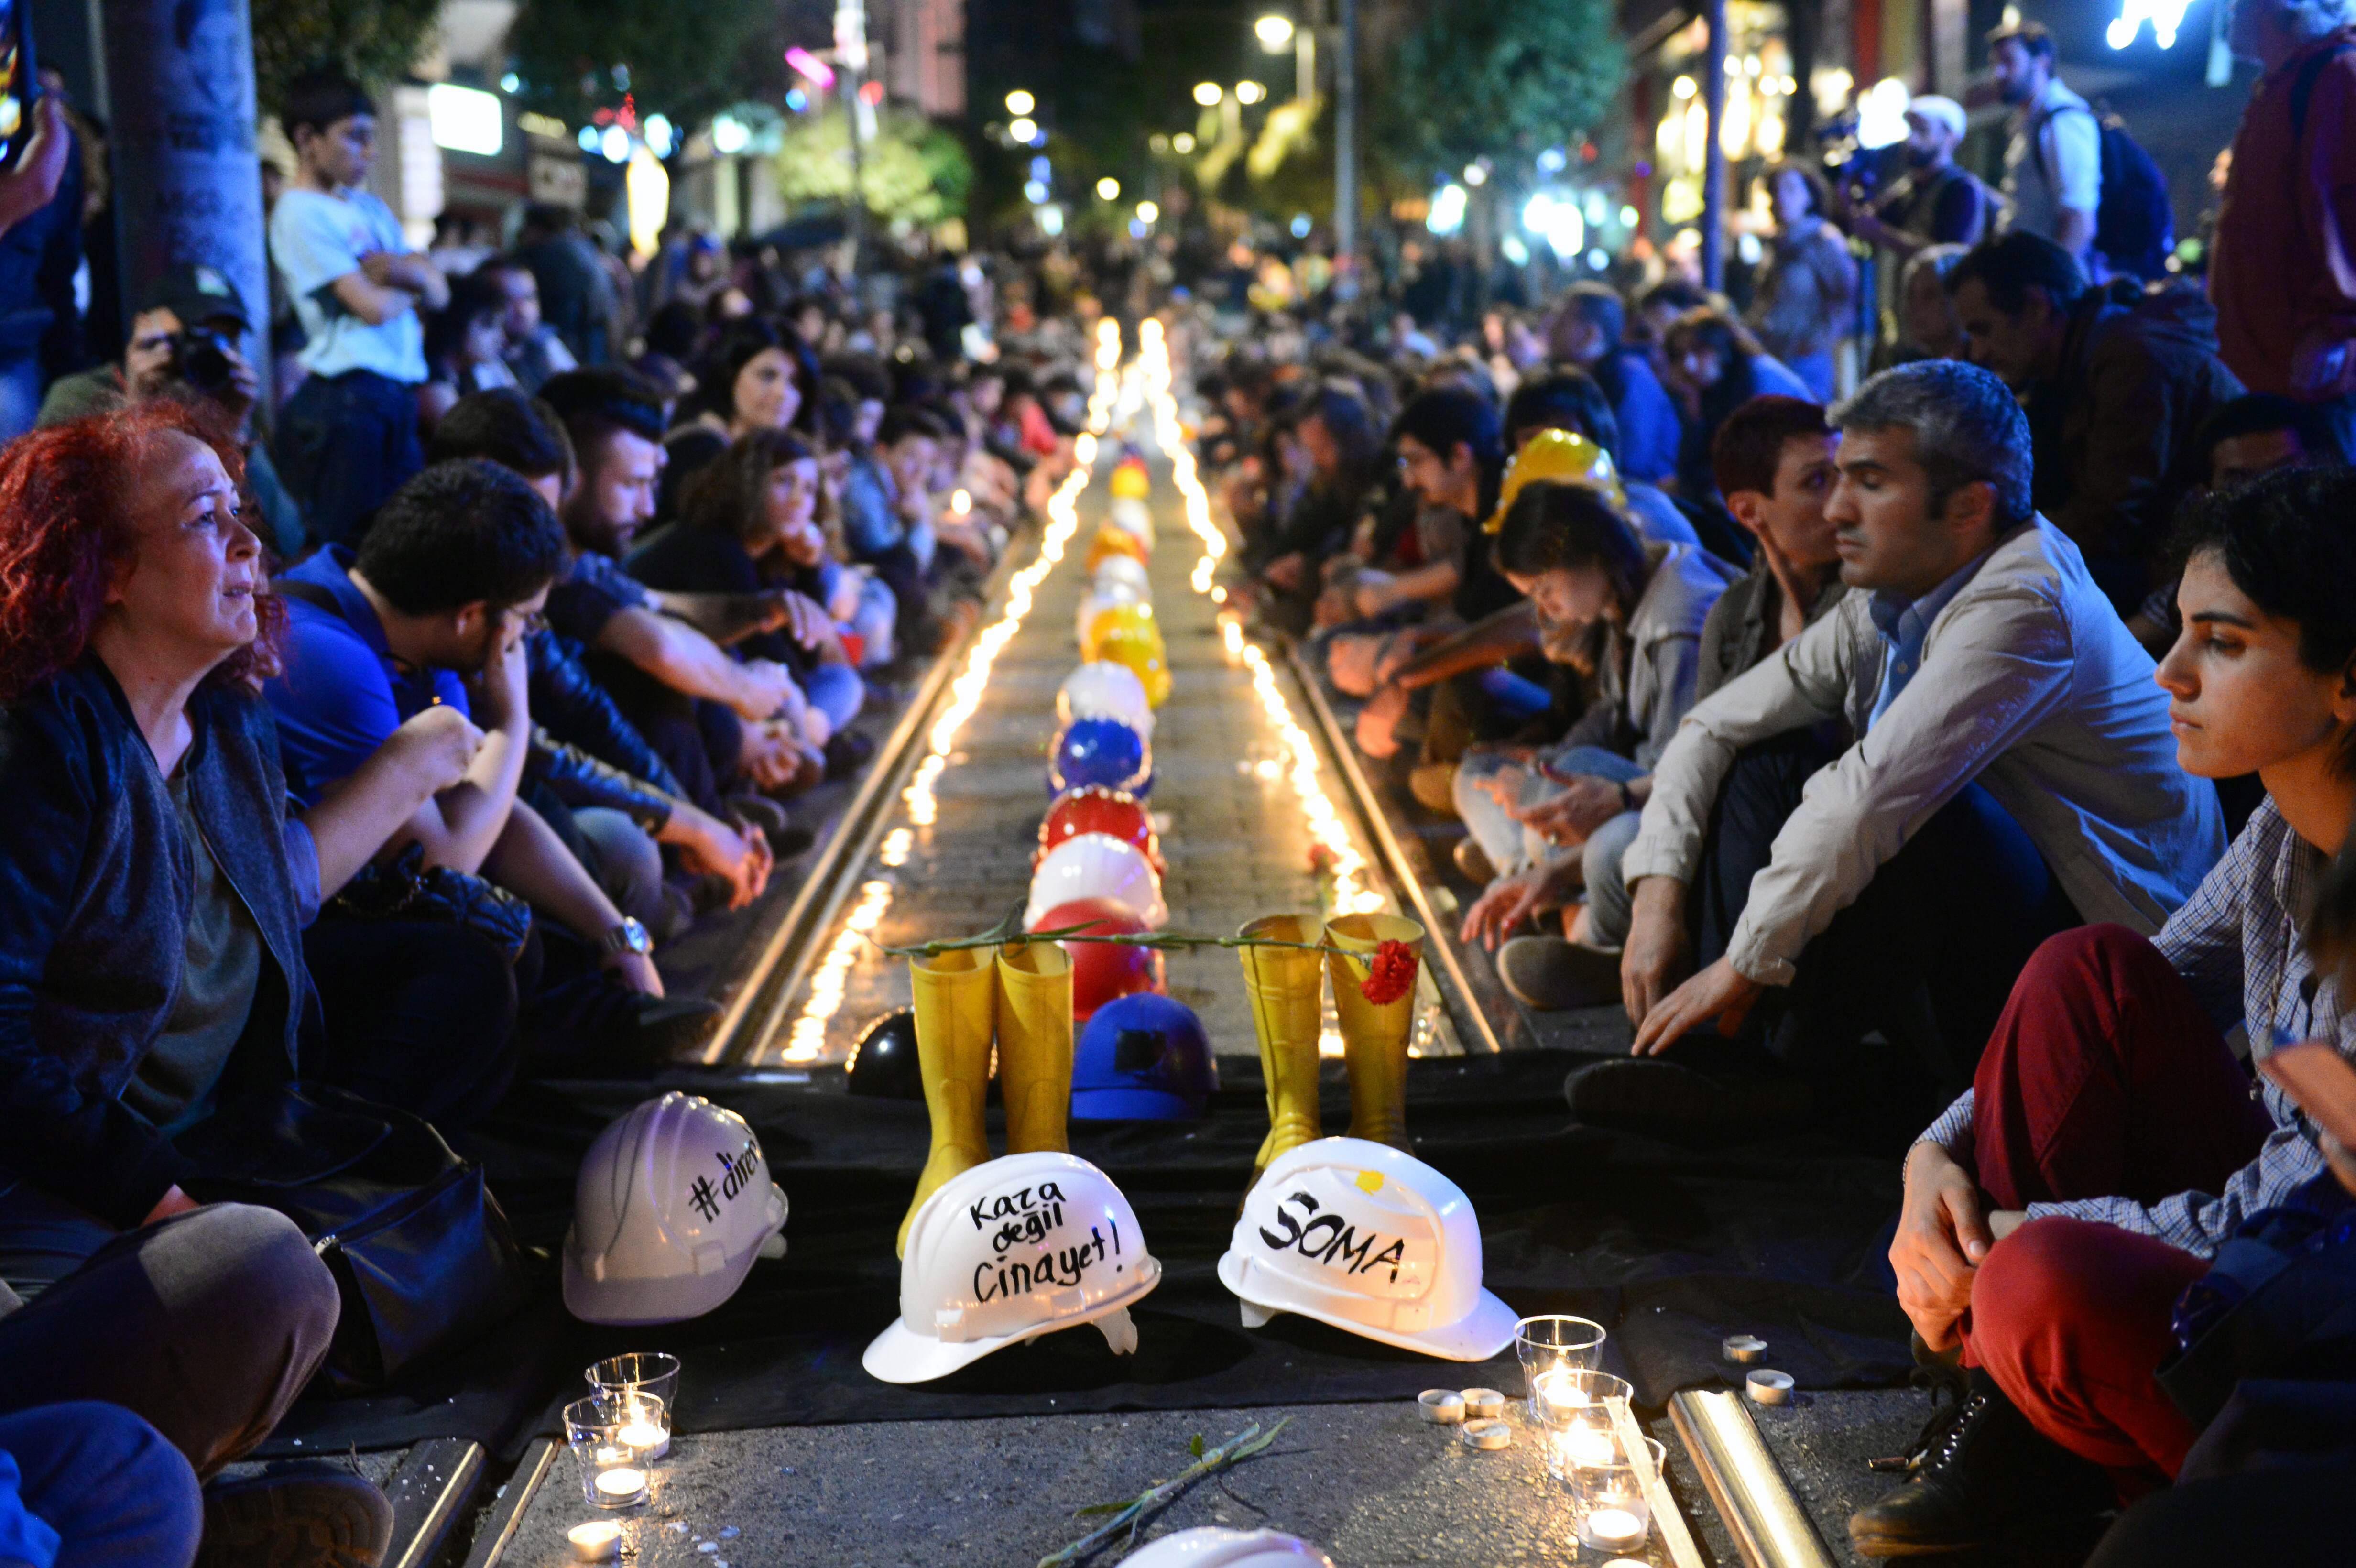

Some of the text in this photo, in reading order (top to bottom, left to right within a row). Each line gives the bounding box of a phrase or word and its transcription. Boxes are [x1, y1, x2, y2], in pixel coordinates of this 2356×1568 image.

[688, 1127, 759, 1223] #diren
[970, 1182, 1066, 1230] Kaza
[992, 1201, 1064, 1252] değil
[1259, 1192, 1405, 1283] SOMA
